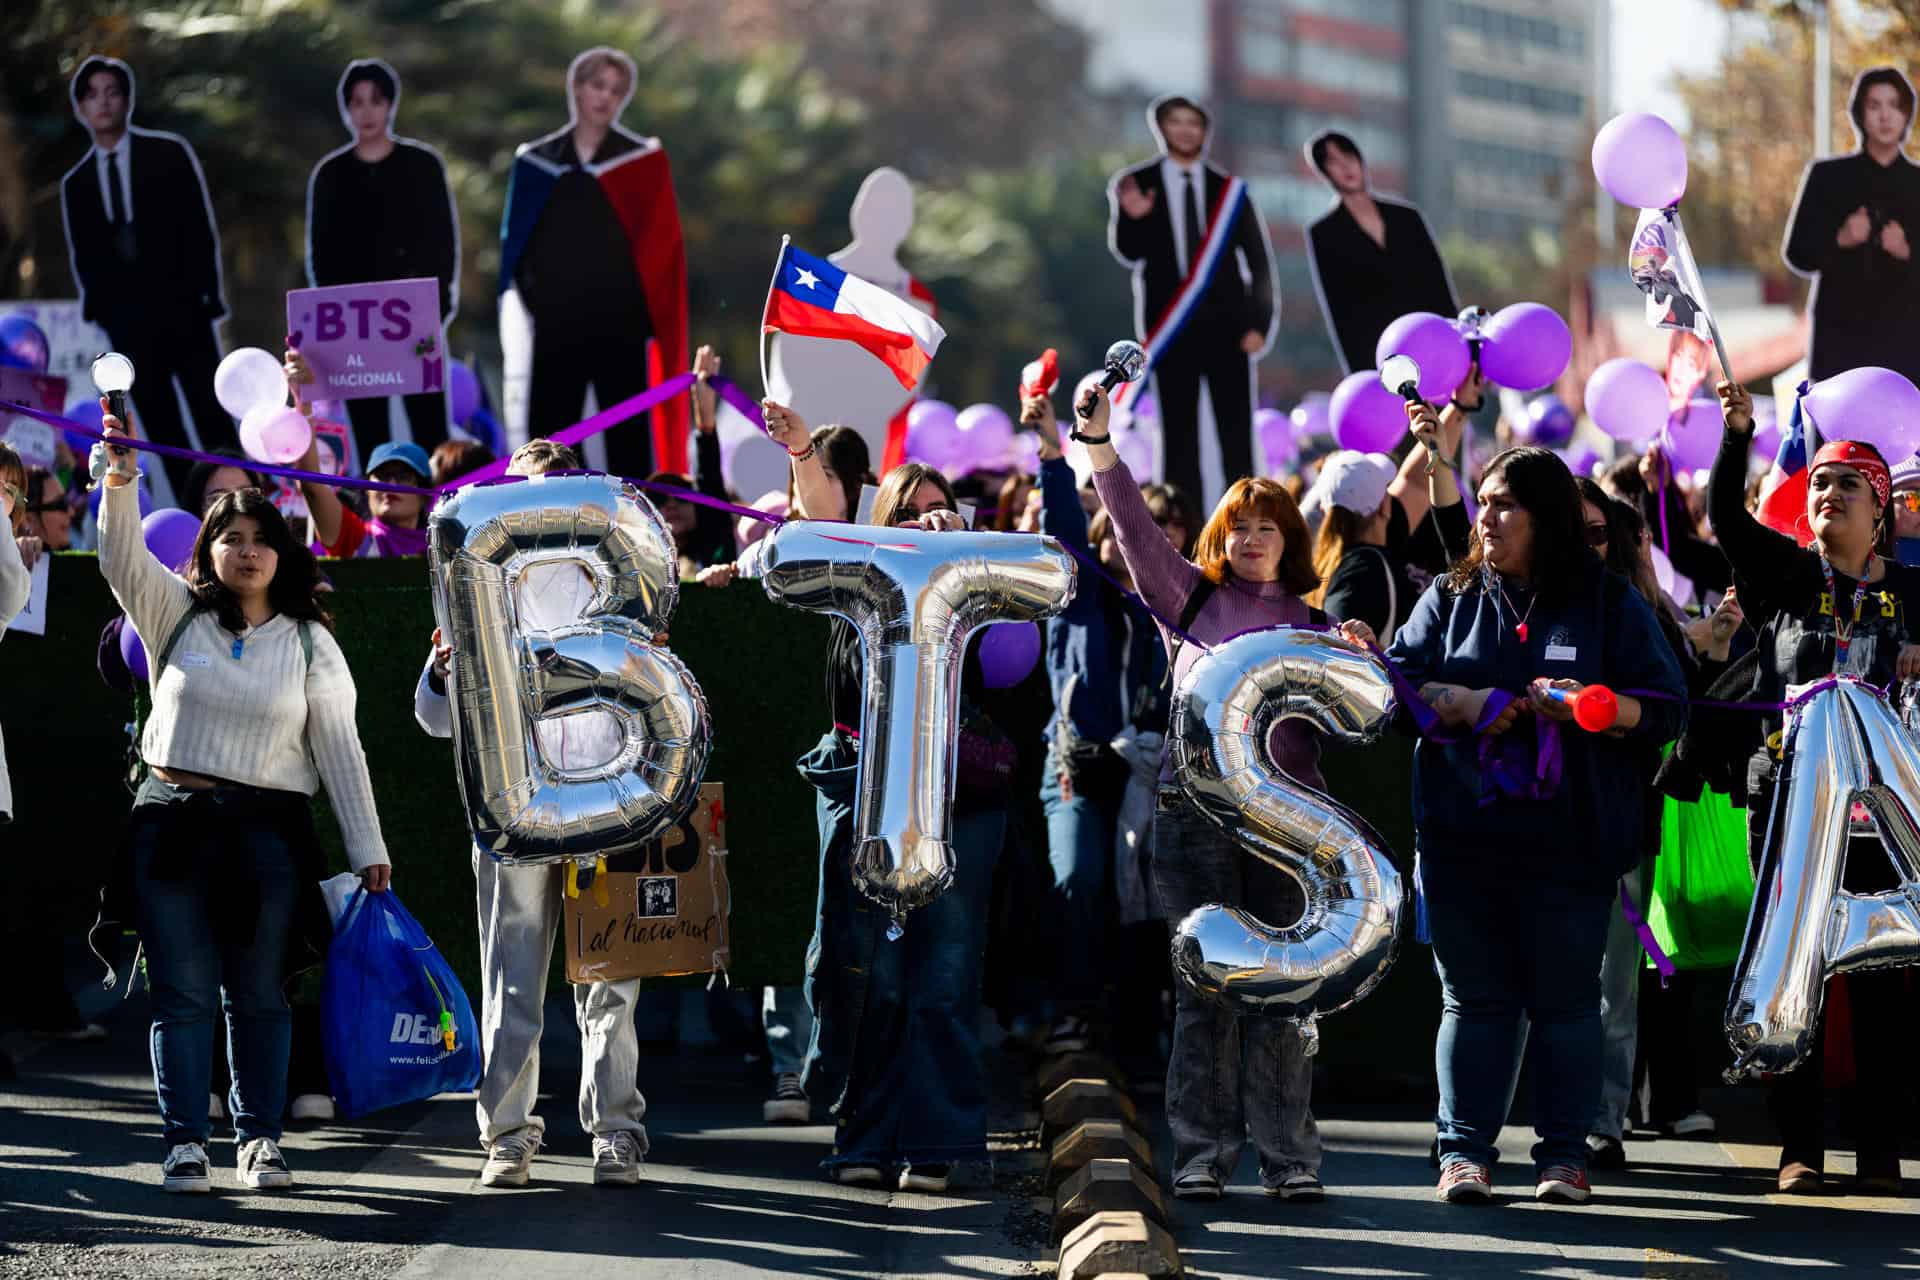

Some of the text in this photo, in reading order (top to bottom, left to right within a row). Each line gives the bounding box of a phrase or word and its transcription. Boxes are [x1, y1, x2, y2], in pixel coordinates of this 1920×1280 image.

[316, 298, 412, 342] BTS
[346, 353, 365, 368] AL
[328, 371, 405, 387] NACIONAL
